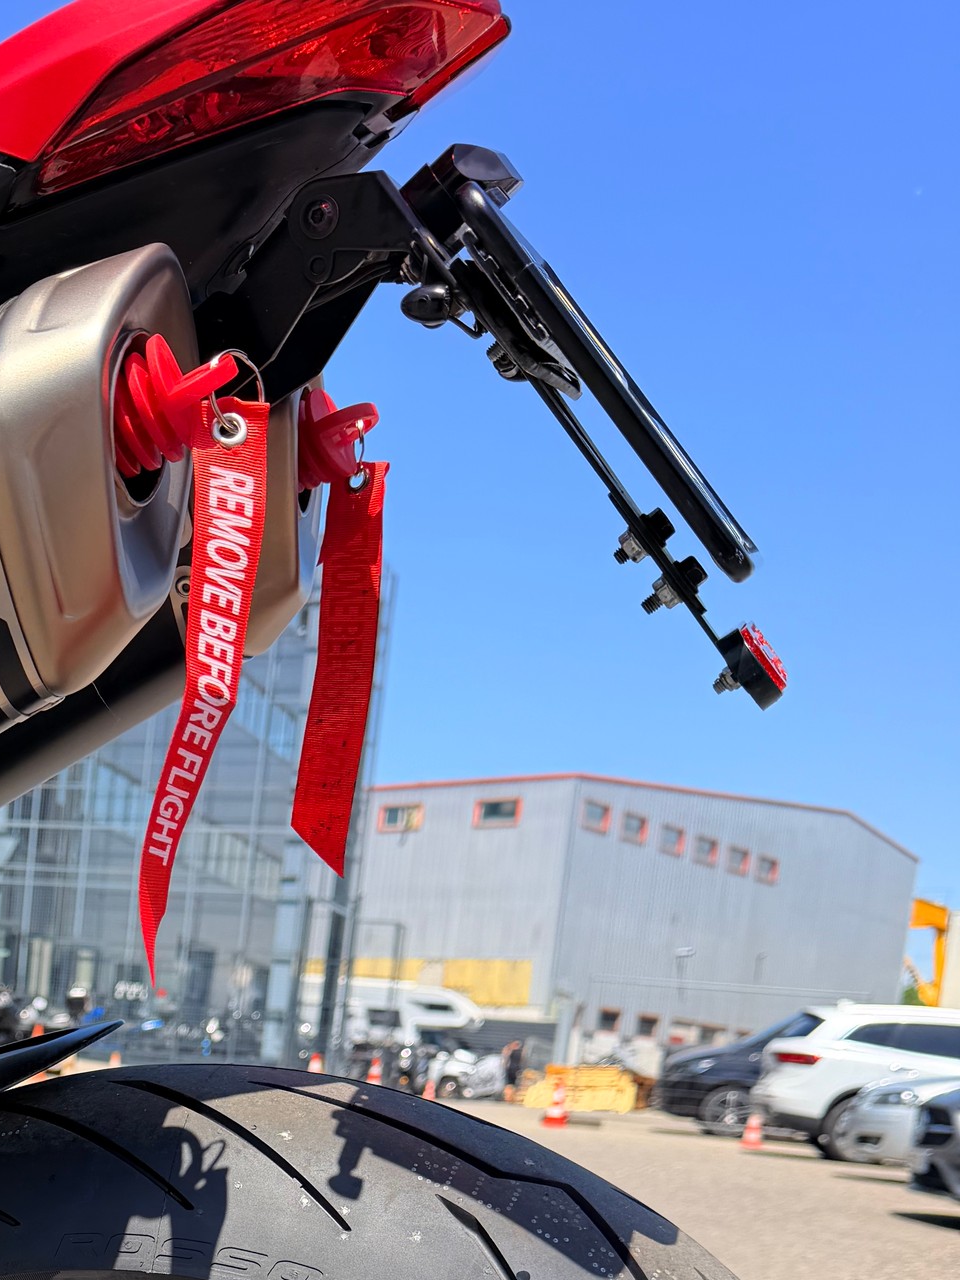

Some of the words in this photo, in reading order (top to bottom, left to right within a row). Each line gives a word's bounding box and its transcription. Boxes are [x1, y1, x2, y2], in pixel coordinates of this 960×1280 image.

[202, 466, 255, 615] REMOVE
[182, 609, 238, 751] BEFORE
[148, 748, 203, 866] FLIGHT
